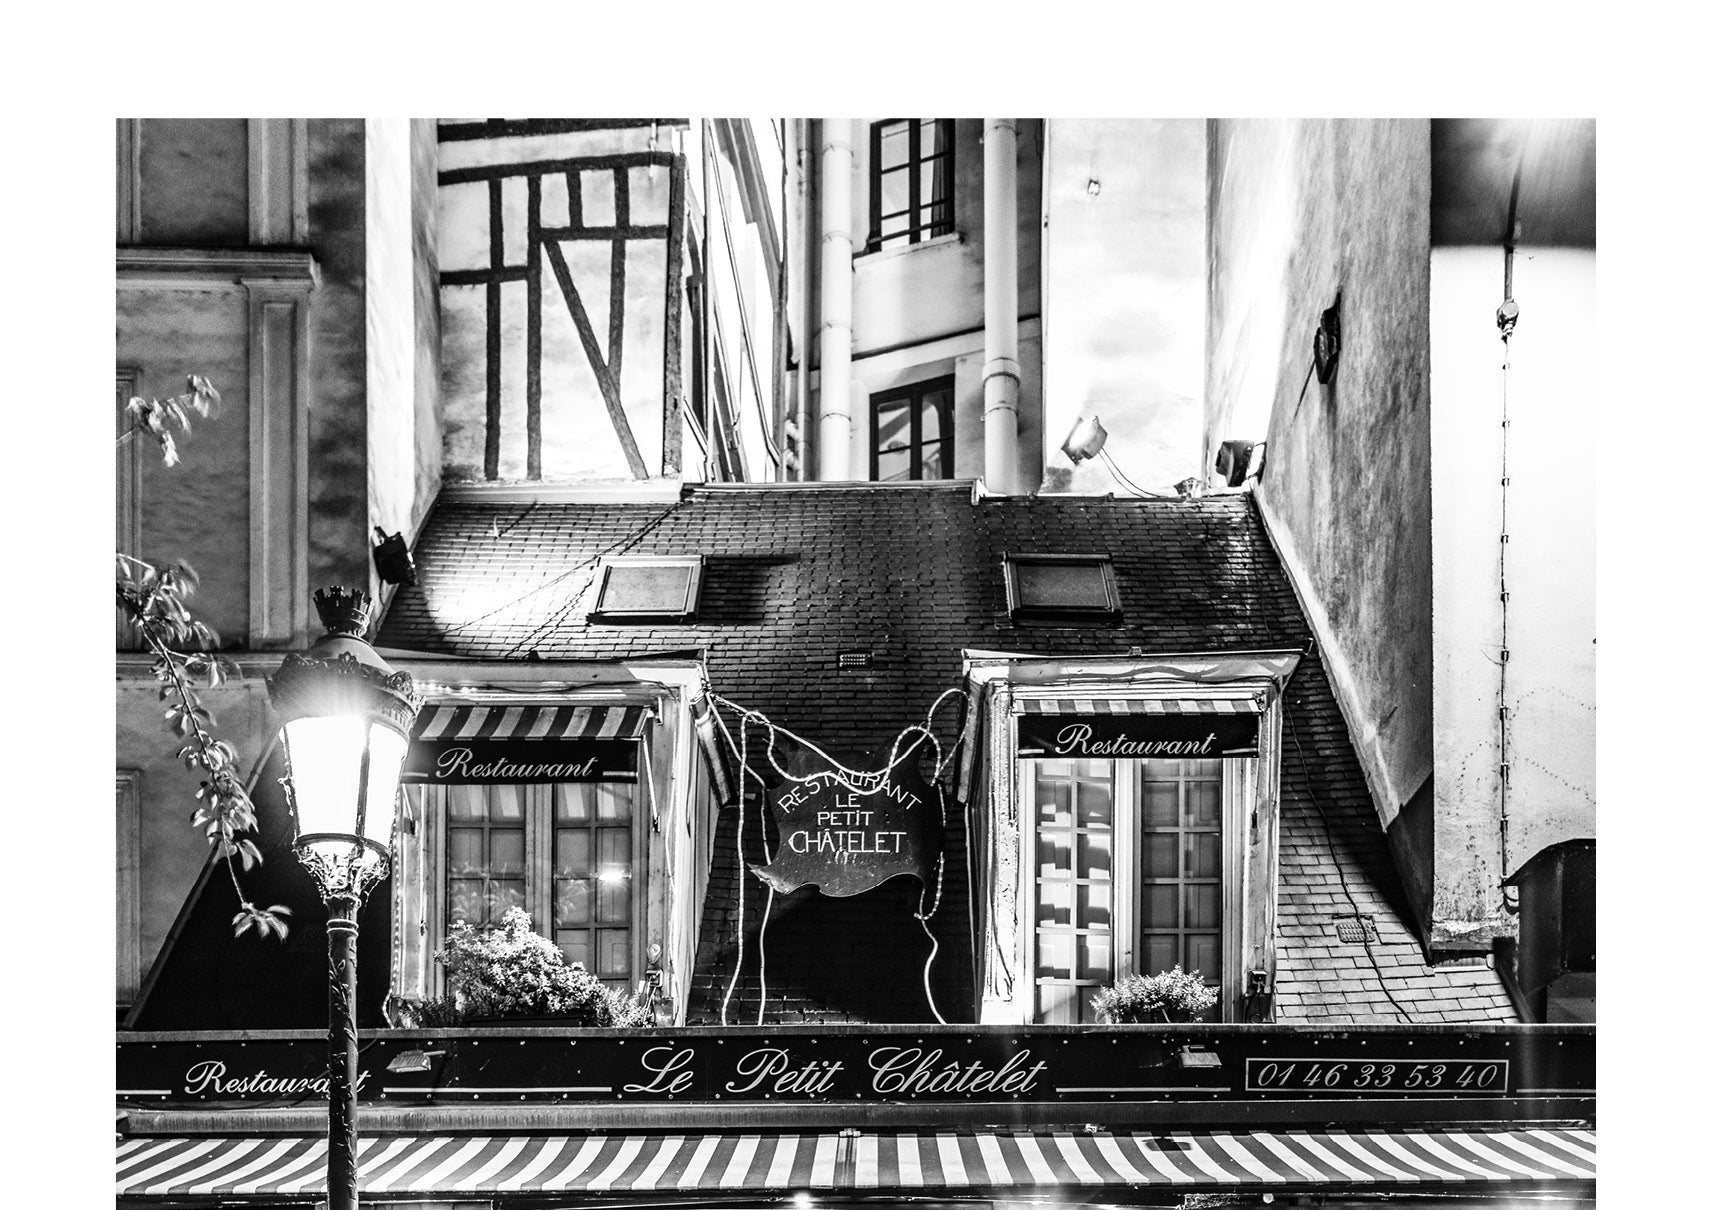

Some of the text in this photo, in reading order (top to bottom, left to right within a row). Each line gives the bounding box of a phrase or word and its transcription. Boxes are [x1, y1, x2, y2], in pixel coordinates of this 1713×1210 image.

[1054, 723, 1217, 755] Restaurant
[435, 747, 599, 778] Restaurant
[777, 769, 922, 814] RESTAURANT
[835, 794, 861, 808] LE
[184, 1060, 372, 1095] Restaurat
[623, 1046, 1048, 1094] Le Petit Châtelet
[1257, 1063, 1498, 1088] 01 46 33 53 40
